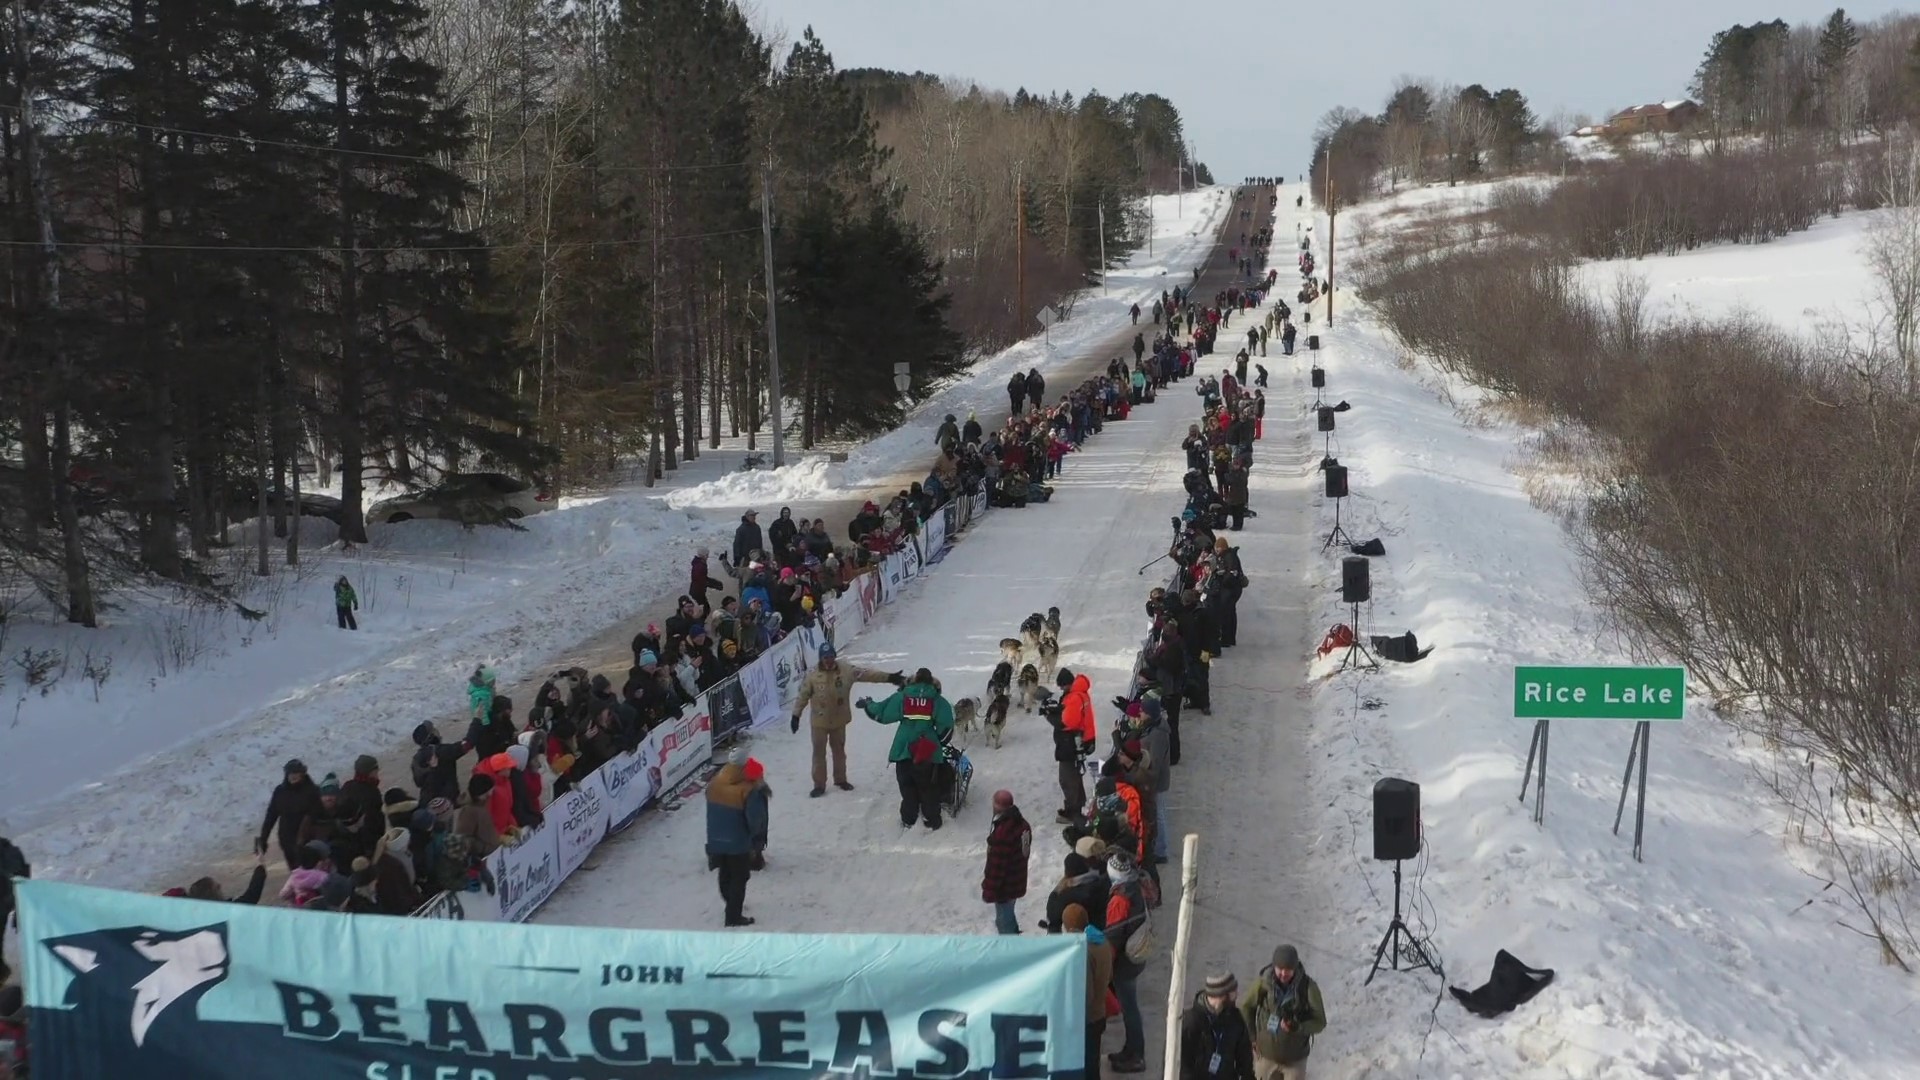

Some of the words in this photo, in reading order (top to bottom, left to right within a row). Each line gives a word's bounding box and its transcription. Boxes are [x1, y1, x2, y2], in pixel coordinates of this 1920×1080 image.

[1524, 682, 1587, 703] Rice
[1604, 683, 1673, 703] Lake
[567, 787, 596, 815] GRAND
[563, 799, 601, 834] PORTAGE
[601, 963, 684, 985] JOHN
[273, 980, 1050, 1080] BEARGREASE
